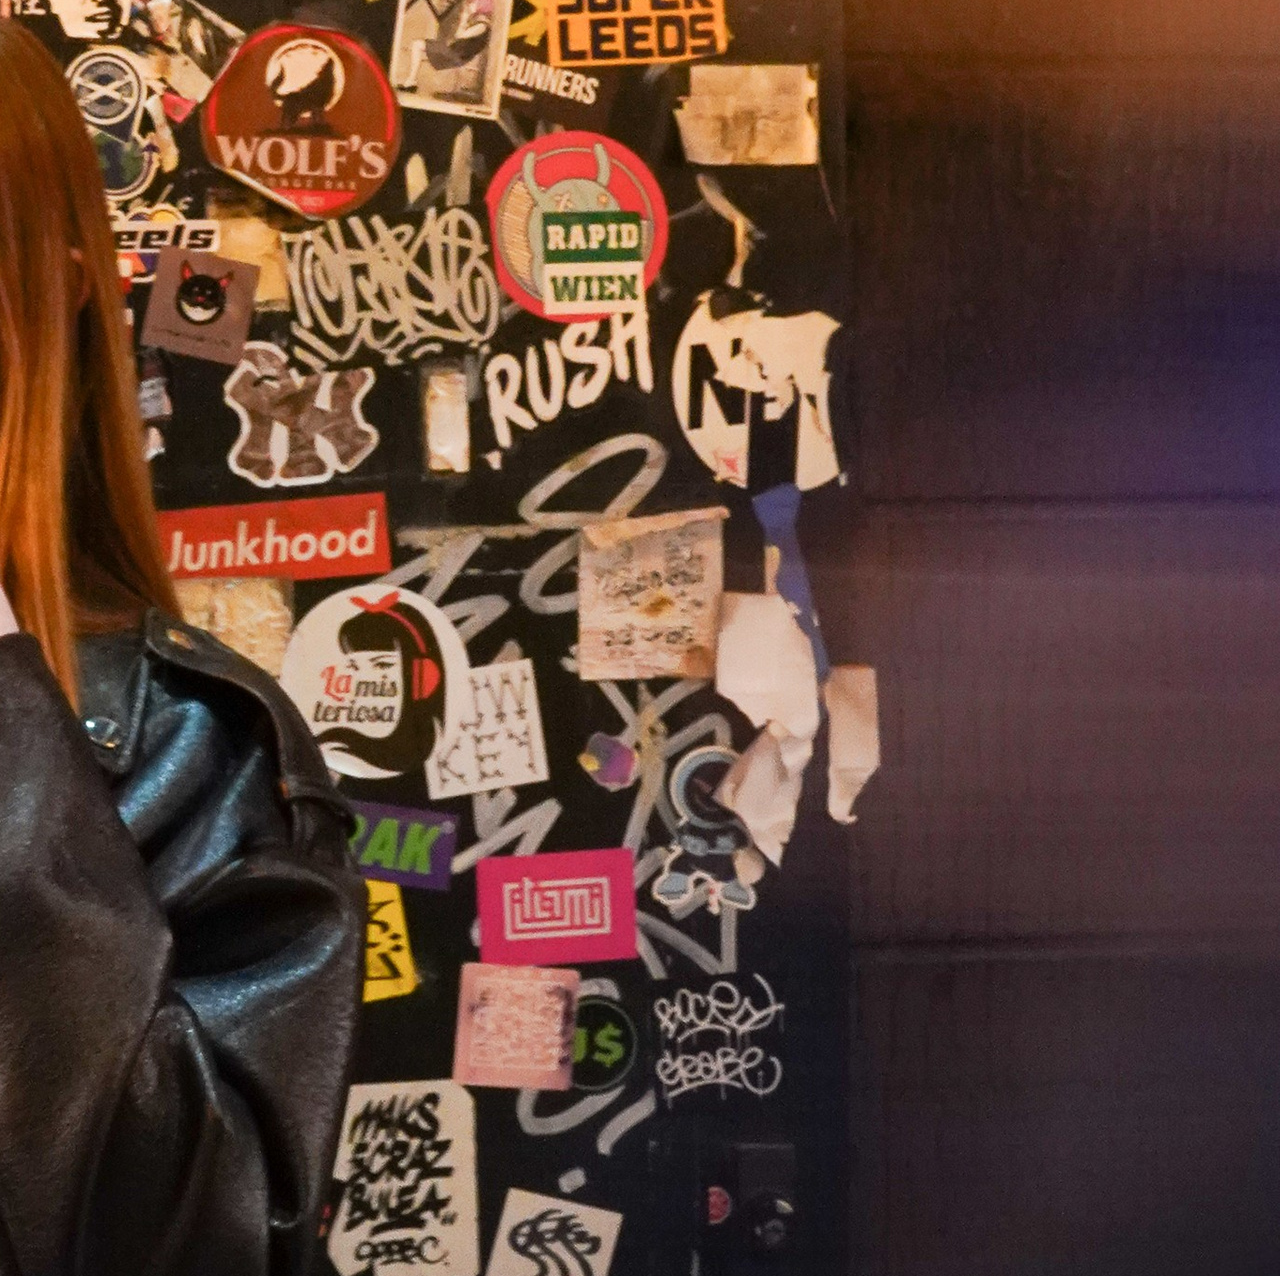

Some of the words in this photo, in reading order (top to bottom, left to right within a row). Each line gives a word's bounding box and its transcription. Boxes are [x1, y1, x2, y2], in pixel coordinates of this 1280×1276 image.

[558, 15, 719, 61] LEEDS
[504, 57, 600, 105] RUNNERS
[215, 134, 389, 179] WOLF'S
[547, 221, 640, 252] RAPID
[548, 272, 640, 304] WIEN
[485, 311, 654, 448] RUSH
[166, 509, 378, 571] Junkhood
[320, 665, 352, 702] La
[354, 674, 398, 698] mis
